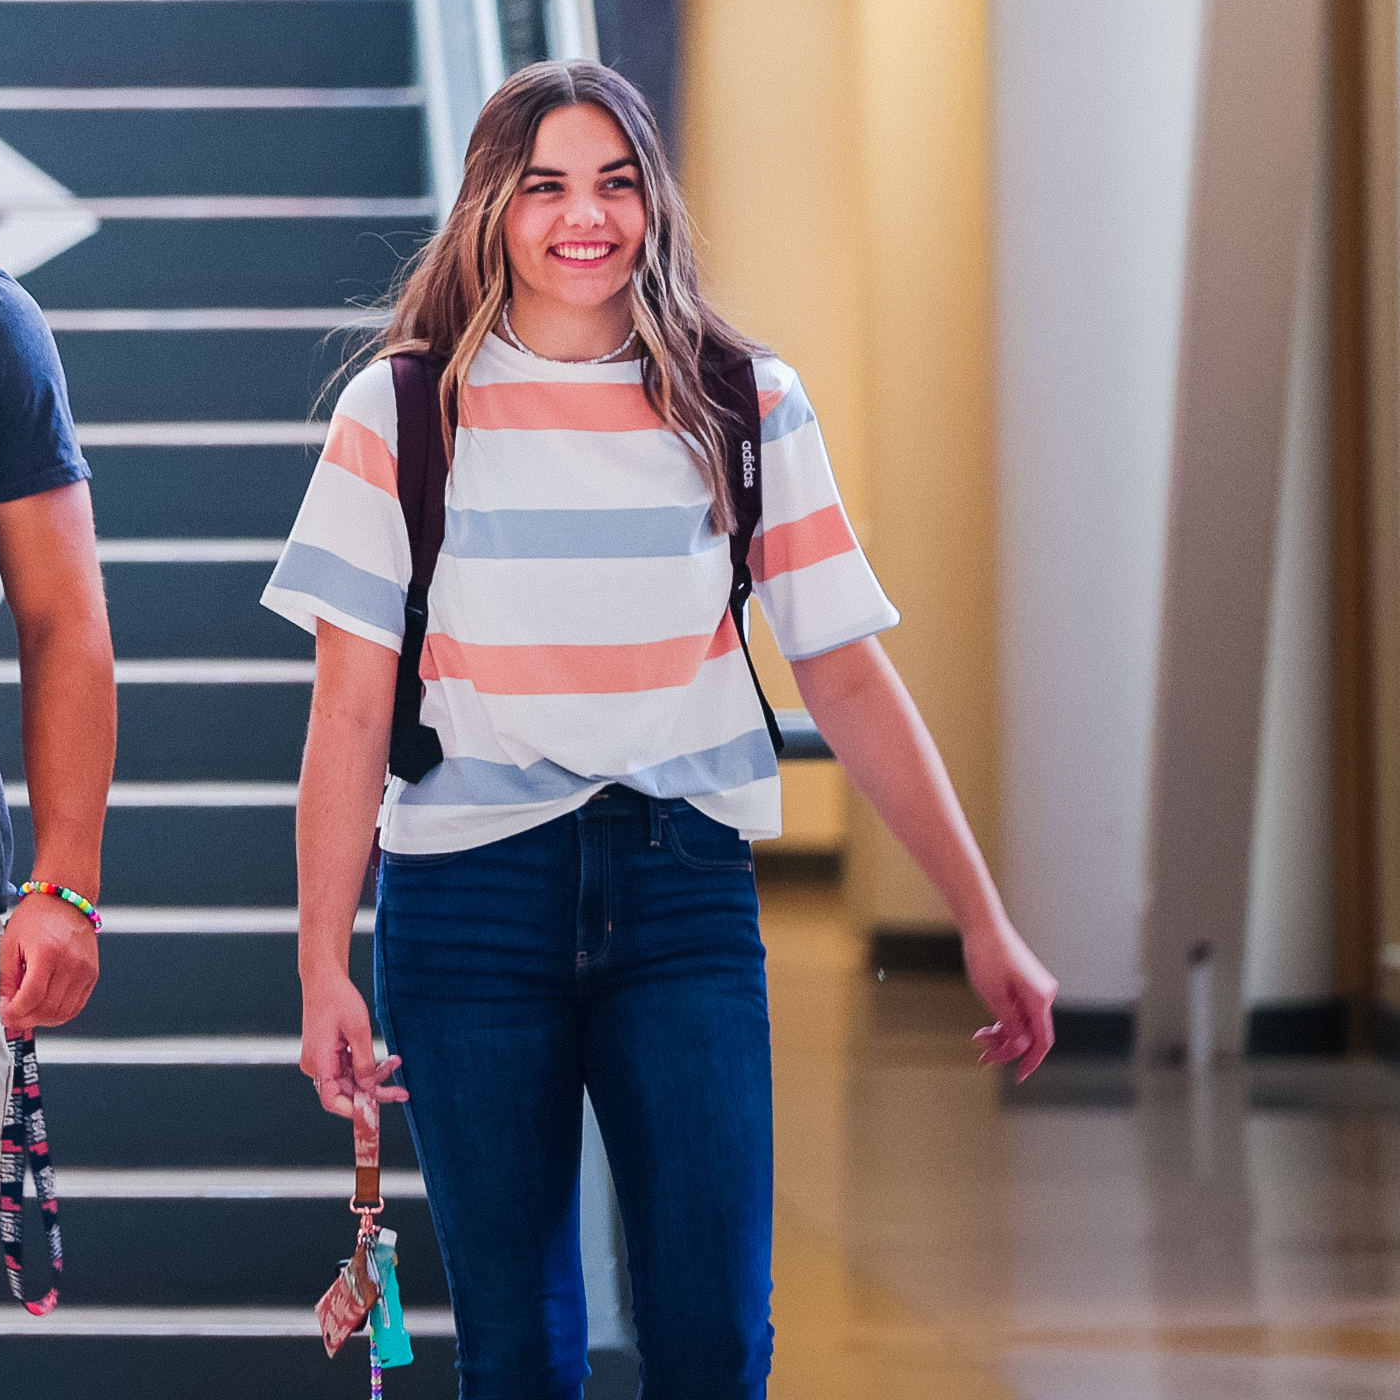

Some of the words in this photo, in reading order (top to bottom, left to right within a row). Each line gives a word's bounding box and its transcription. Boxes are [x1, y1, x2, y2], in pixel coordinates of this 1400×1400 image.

[742, 440, 756, 489] adidas
[23, 1052, 39, 1084] USA
[30, 1108, 47, 1142] USA
[0, 1154, 16, 1183] USA
[0, 1211, 15, 1243] USA
